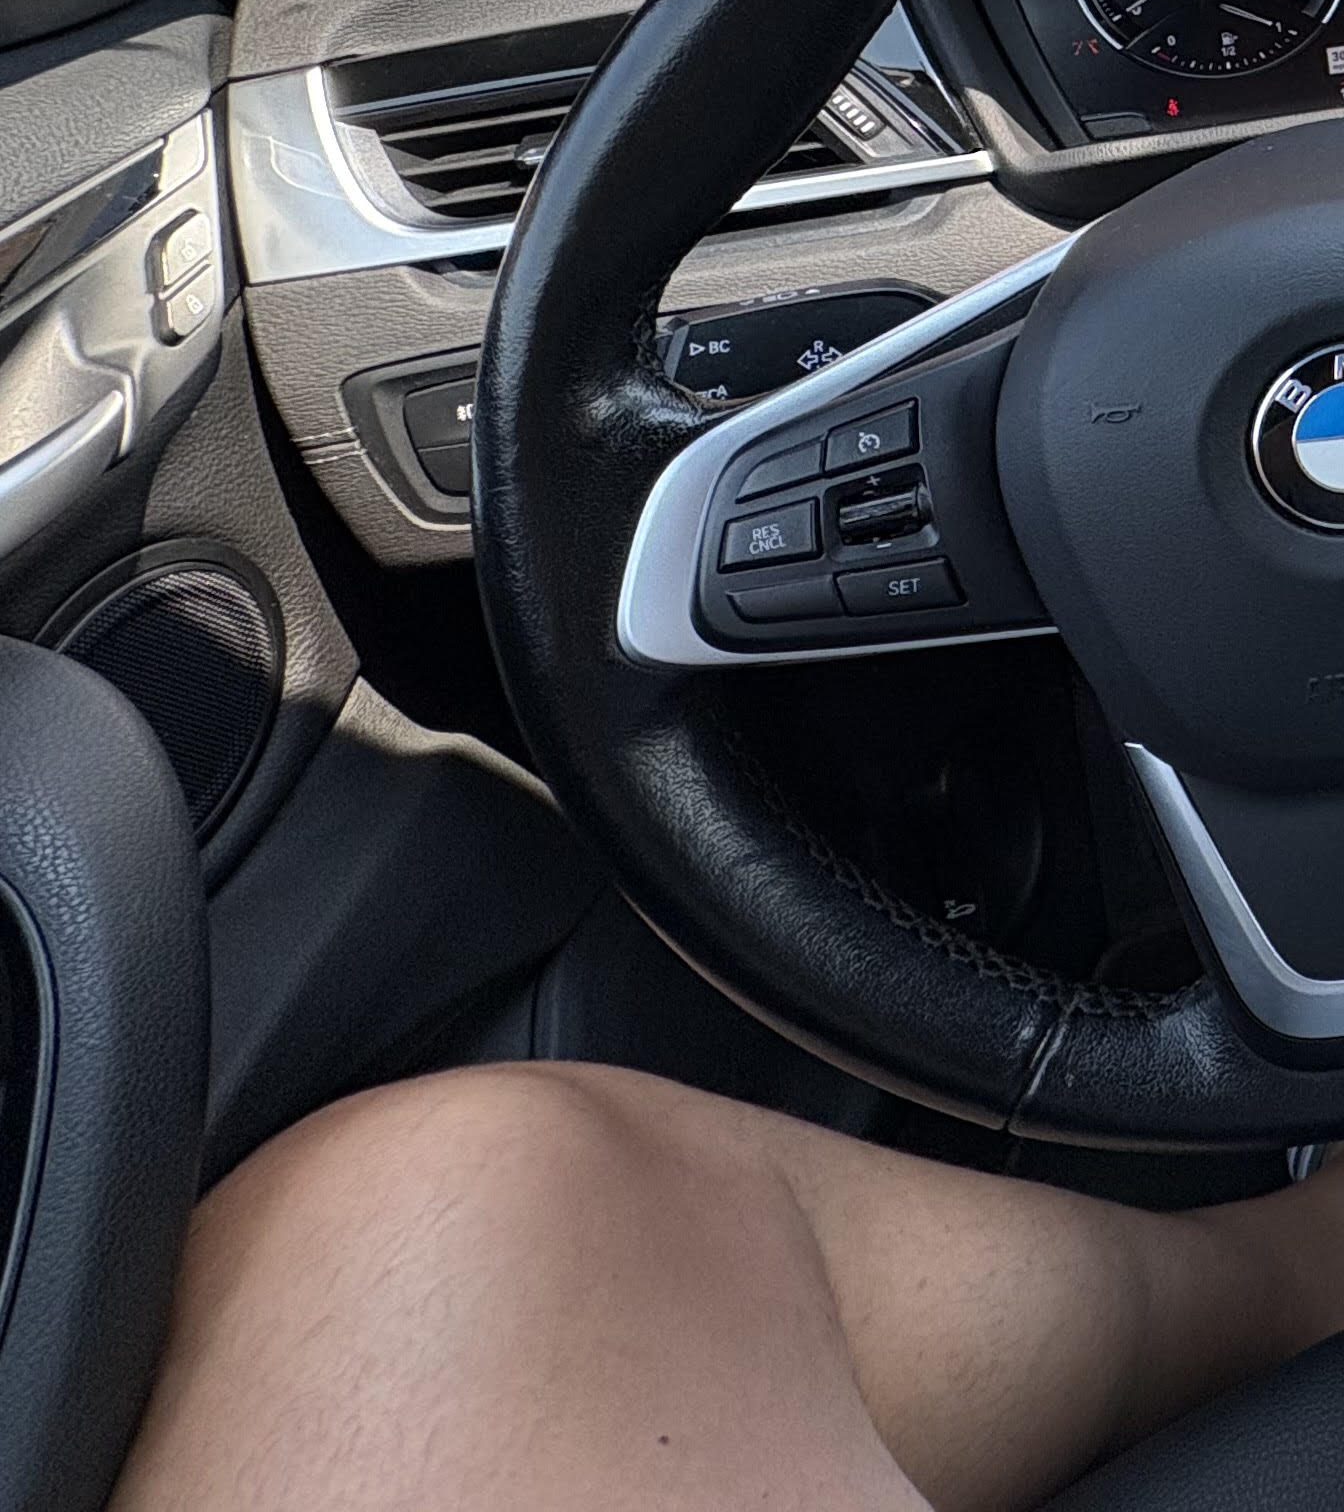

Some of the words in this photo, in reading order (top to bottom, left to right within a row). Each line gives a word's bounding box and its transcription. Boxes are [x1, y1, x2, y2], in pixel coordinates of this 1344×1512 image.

[1221, 46, 1236, 56] 1/2
[708, 340, 731, 355] BC
[813, 340, 824, 353] R
[752, 523, 780, 538] RES
[749, 536, 786, 555] CNCL
[888, 578, 920, 596] SET
